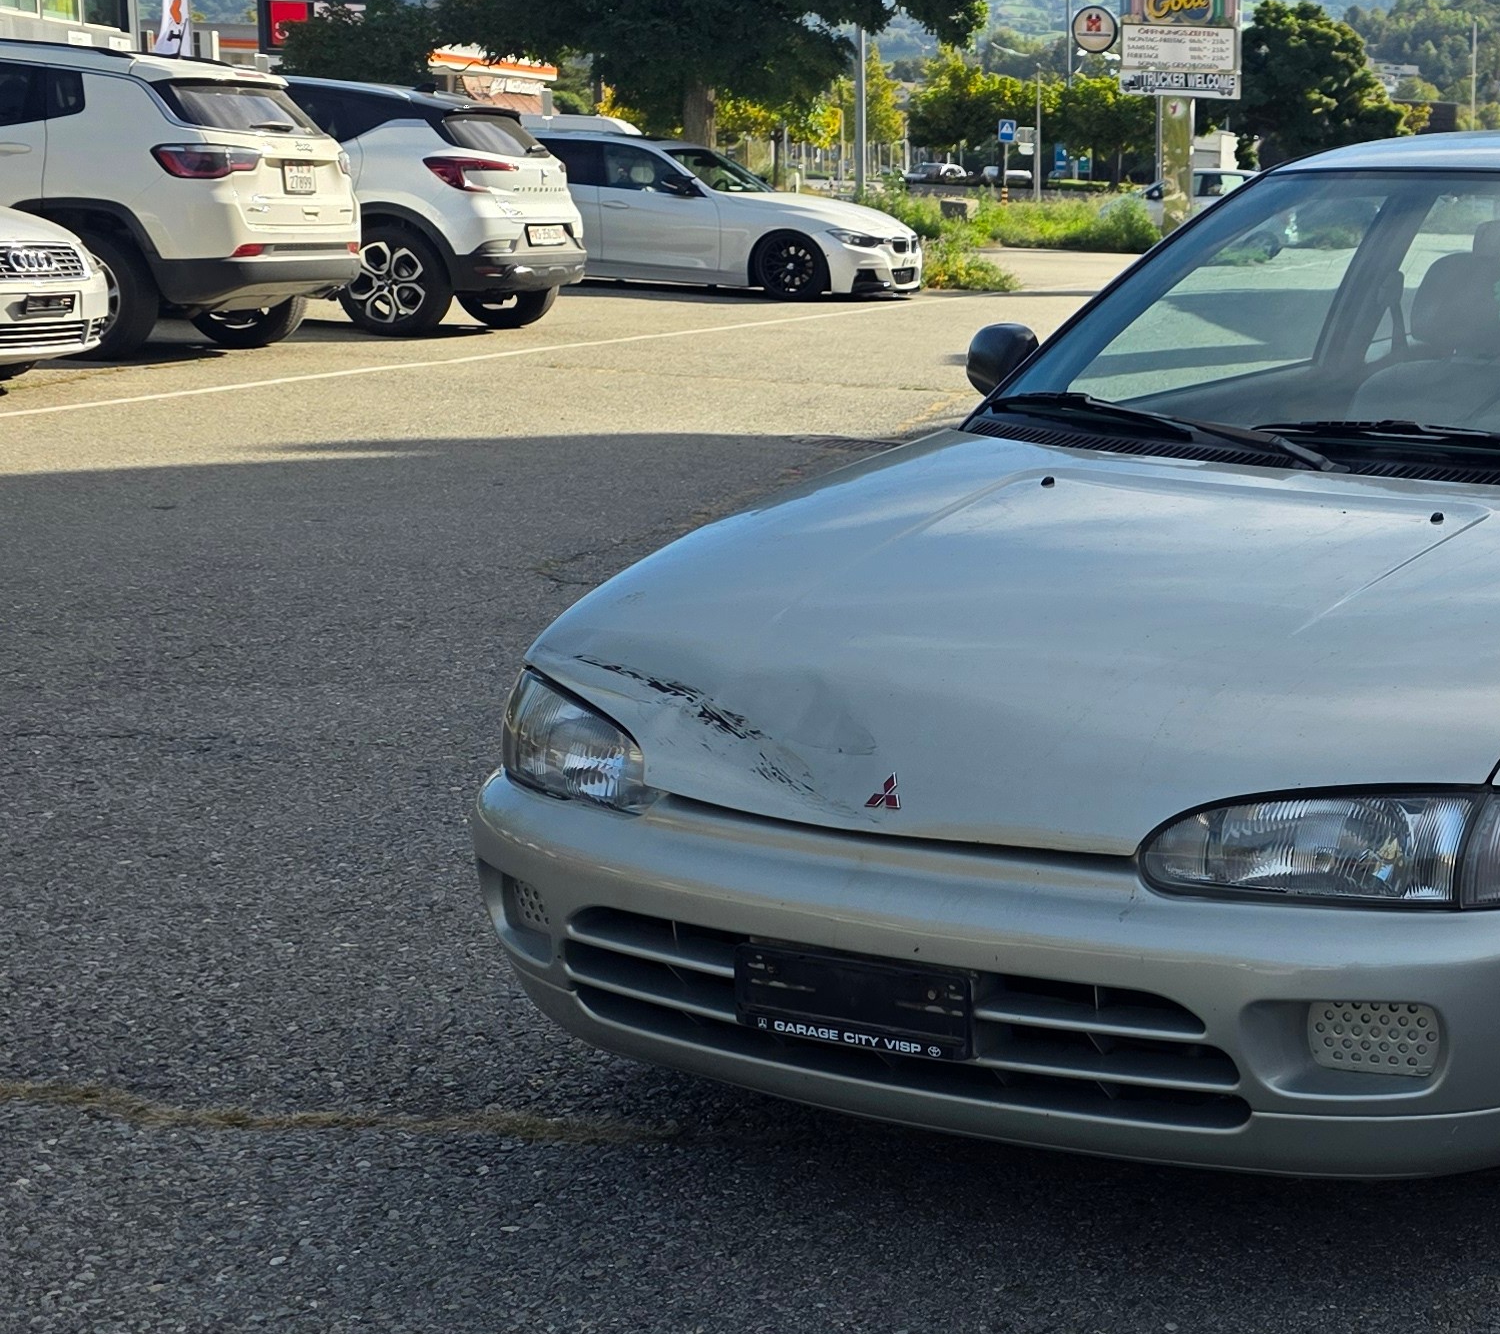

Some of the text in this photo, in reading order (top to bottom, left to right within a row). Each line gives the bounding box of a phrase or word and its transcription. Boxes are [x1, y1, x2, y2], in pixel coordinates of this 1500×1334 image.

[1141, 71, 1235, 88] TRUCKER WELCOME
[774, 1020, 922, 1054] GARAGE CITY VISP
